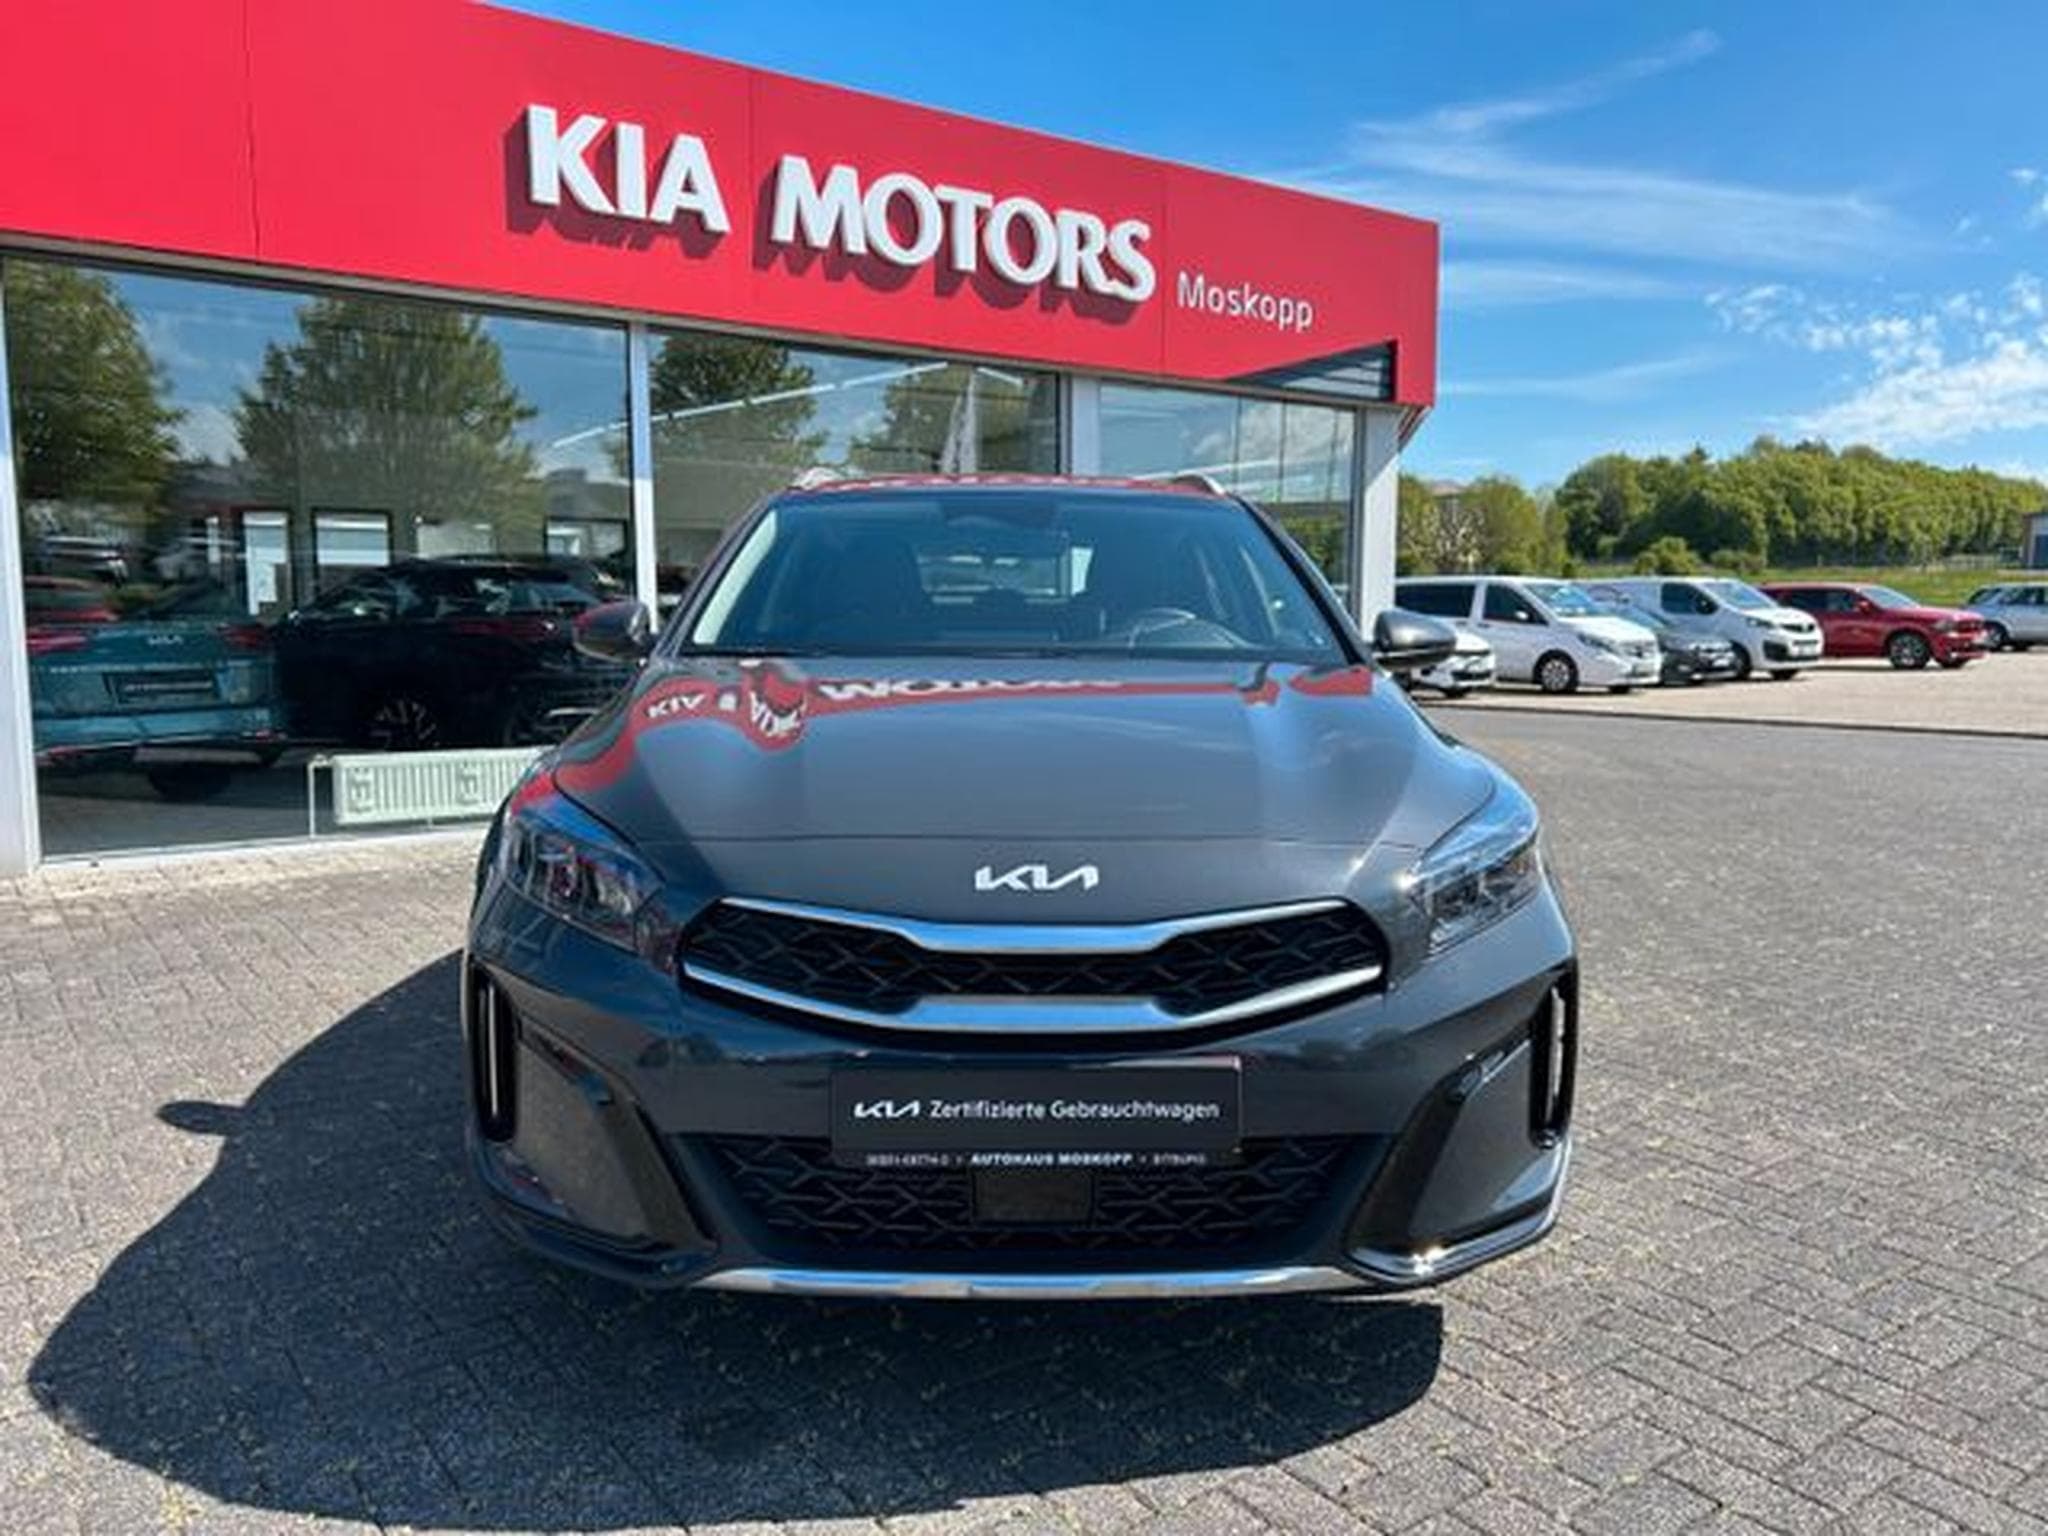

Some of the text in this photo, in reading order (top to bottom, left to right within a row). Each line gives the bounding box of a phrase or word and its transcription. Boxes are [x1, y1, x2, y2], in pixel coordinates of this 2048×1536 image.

[524, 104, 1157, 305] KIA MOTORS
[1176, 270, 1315, 332] Moskopp
[974, 864, 1099, 892] KIA
[853, 1100, 1220, 1125] KIA Zertifizierte Gebrauchtwagen
[971, 1152, 1054, 1167] AUTOHAUS
[1058, 1152, 1133, 1167] MOSKOPP
